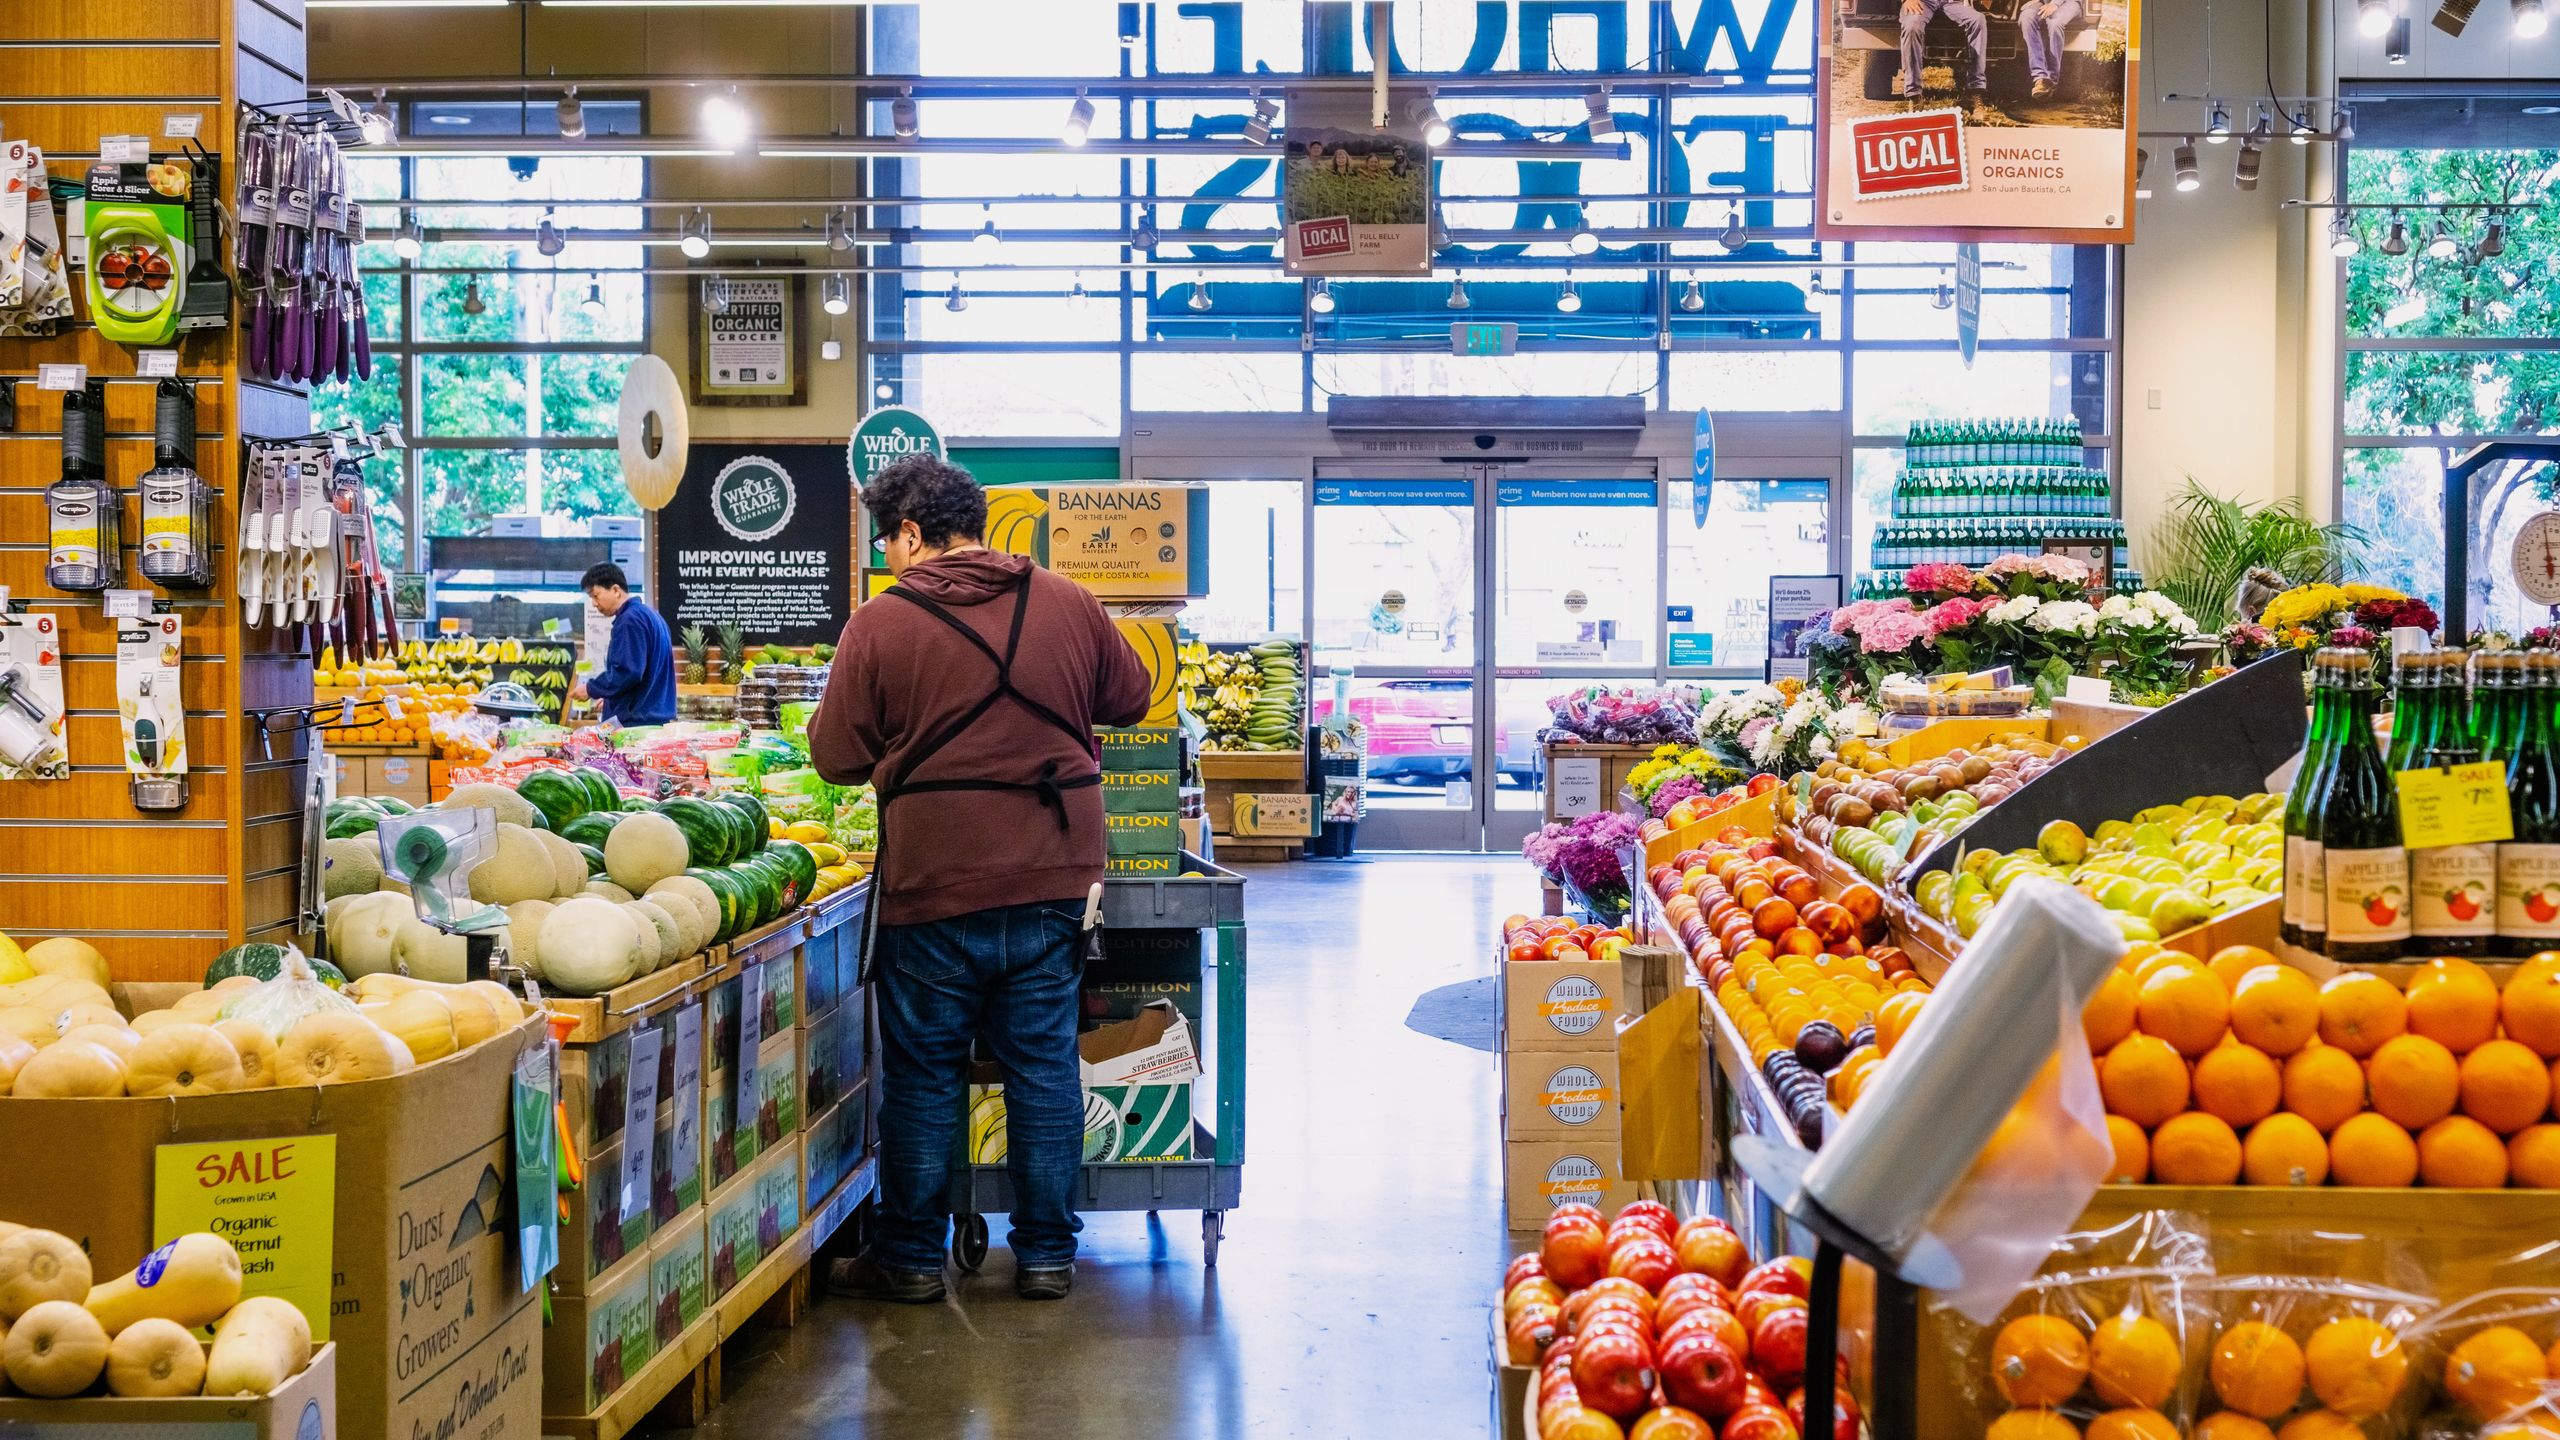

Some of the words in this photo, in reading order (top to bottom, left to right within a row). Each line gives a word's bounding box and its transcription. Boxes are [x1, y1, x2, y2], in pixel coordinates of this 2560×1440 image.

[13, 148, 20, 158] 5
[1862, 132, 1955, 174] LOCAL
[1983, 148, 2060, 161] PINNACLE
[1982, 166, 2065, 179] ORGANICS
[91, 176, 118, 186] Apple
[91, 185, 115, 194] Corer
[116, 185, 123, 194] &
[125, 185, 150, 194] Slicer
[1982, 184, 1997, 193] San
[1999, 185, 2019, 193] Juan
[2021, 184, 2056, 194] Bautista,
[2058, 185, 2072, 193] CA
[1302, 227, 1347, 248] LOCAL
[714, 318, 781, 331] ORGANIC
[716, 333, 778, 342] GROCER
[861, 431, 932, 454] WHOLE
[722, 477, 776, 504] WHOLE
[1317, 487, 1340, 496] prime
[1349, 490, 1386, 498] Members
[1388, 490, 1405, 498] now
[1406, 490, 1424, 498] save
[1424, 490, 1443, 498] even
[1445, 490, 1467, 498] more.
[1499, 487, 1523, 496] prime
[1531, 490, 1569, 498] Members
[1570, 490, 1587, 498] now
[1588, 490, 1606, 498] save
[1607, 490, 1626, 498] even
[1627, 490, 1650, 498] more.
[729, 489, 780, 517] TRADE
[1058, 492, 1162, 511] BANANAS
[58, 506, 88, 514] Microplane
[735, 503, 782, 523] GUARANTEE
[678, 550, 776, 564] IMPROVING
[780, 550, 827, 564] LIVES
[1056, 561, 1099, 570] PREMIUM
[1101, 561, 1140, 570] QUALITY
[678, 566, 713, 578] WITH
[715, 566, 756, 578] EVERY
[679, 583, 690, 592] The
[691, 583, 709, 592] Whole
[730, 583, 761, 592] Guarantee
[762, 583, 788, 592] program
[788, 583, 798, 592] was
[800, 583, 821, 592] created
[823, 583, 829, 592] to
[677, 612, 703, 620] products
[704, 612, 720, 620] helps
[721, 612, 735, 620] fund
[736, 612, 760, 620] projects
[761, 612, 775, 620] such
[777, 612, 784, 620] as
[785, 612, 798, 620] new
[798, 612, 832, 620] community
[41, 621, 49, 630] 5
[166, 621, 173, 631] 5
[752, 619, 772, 627] homes
[773, 619, 782, 627] for
[783, 619, 795, 627] real
[796, 619, 818, 627] people.
[120, 632, 147, 641] zyliss
[1101, 733, 1168, 744] DITION
[1101, 774, 1169, 785] DITION
[1260, 796, 1302, 804] BANANAS
[1100, 982, 1192, 993] EDITION
[1556, 985, 1595, 997] WHOLE
[1550, 999, 1599, 1015] Produce
[1558, 1015, 1593, 1027] FOODS
[1131, 1050, 1189, 1073] STRAWBERRIES
[1556, 1075, 1595, 1087] WHOLE
[1550, 1089, 1599, 1105] Produce
[1558, 1106, 1593, 1117] FOODS
[195, 1144, 296, 1188] SALE
[1556, 1164, 1595, 1176] WHOLE
[1550, 1179, 1599, 1194] Produce
[214, 1194, 245, 1206] Grown
[245, 1194, 255, 1203] in
[256, 1192, 277, 1201] USA
[210, 1214, 280, 1236] Organic
[397, 1210, 446, 1261] Durst
[412, 1250, 472, 1311] Organic
[396, 1317, 460, 1381] Growers
[459, 1353, 500, 1430] Deborah
[502, 1341, 529, 1393] Durst
